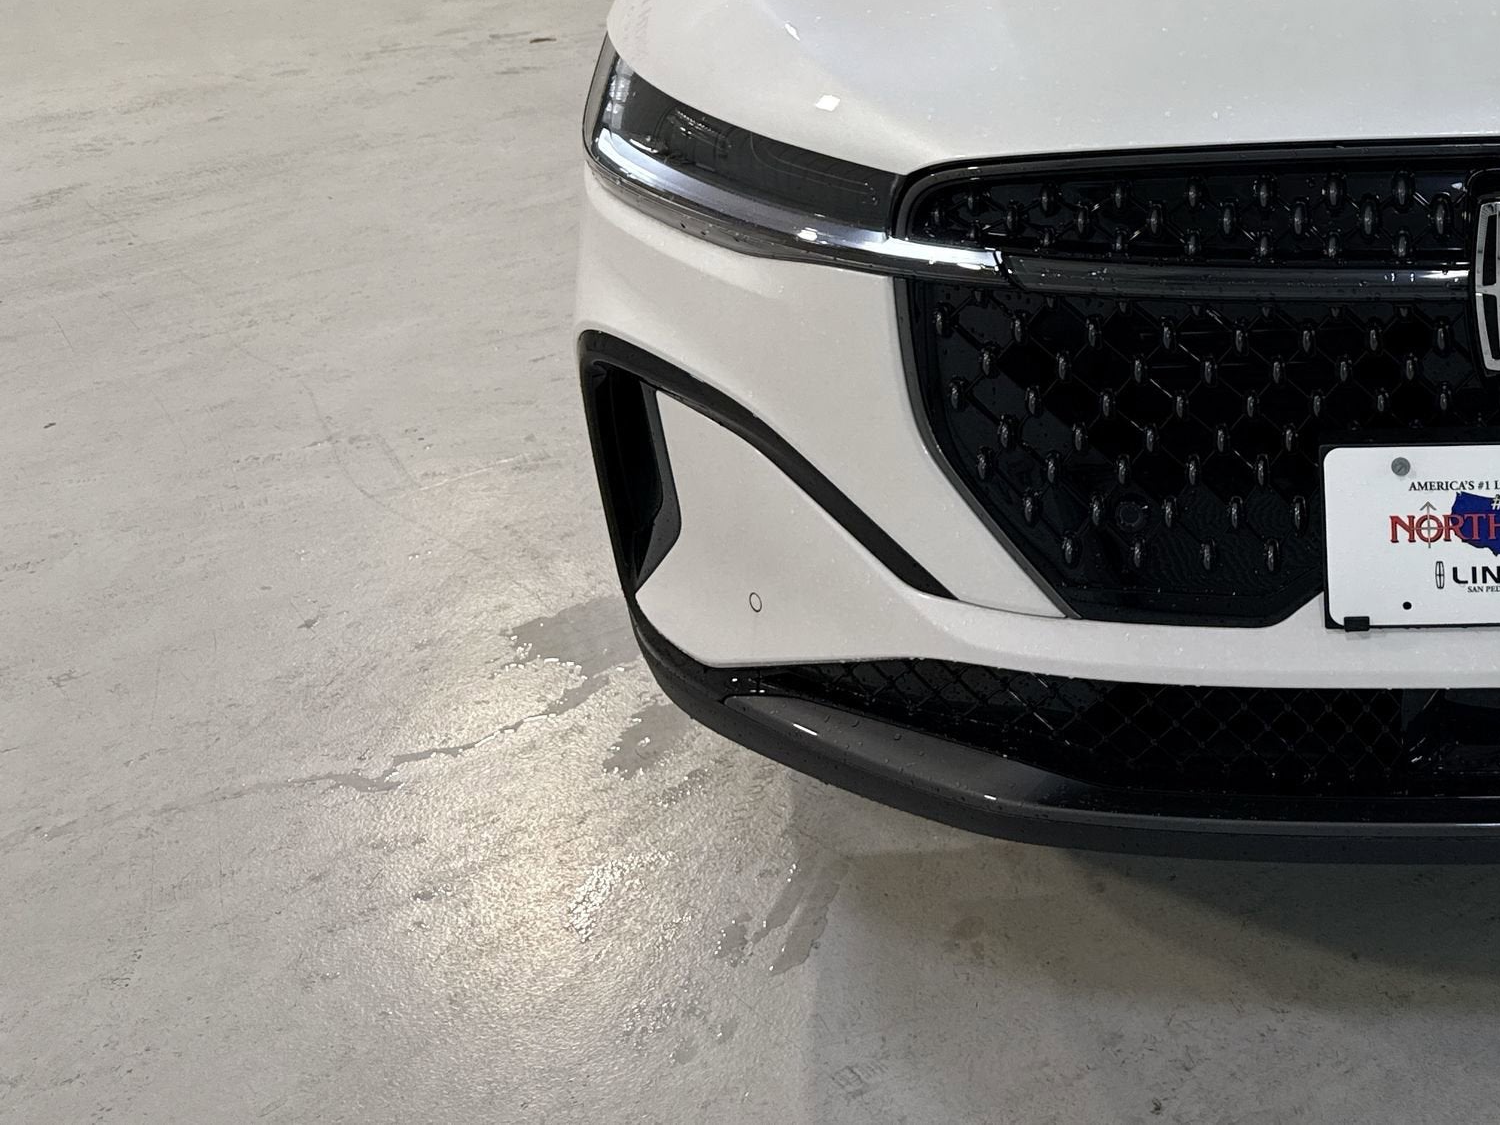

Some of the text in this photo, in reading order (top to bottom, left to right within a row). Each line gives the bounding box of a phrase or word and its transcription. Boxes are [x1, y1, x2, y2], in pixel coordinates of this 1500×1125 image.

[1409, 480, 1475, 492] AMERICA'S
[1477, 480, 1491, 490] #1
[1467, 585, 1484, 593] SAN
